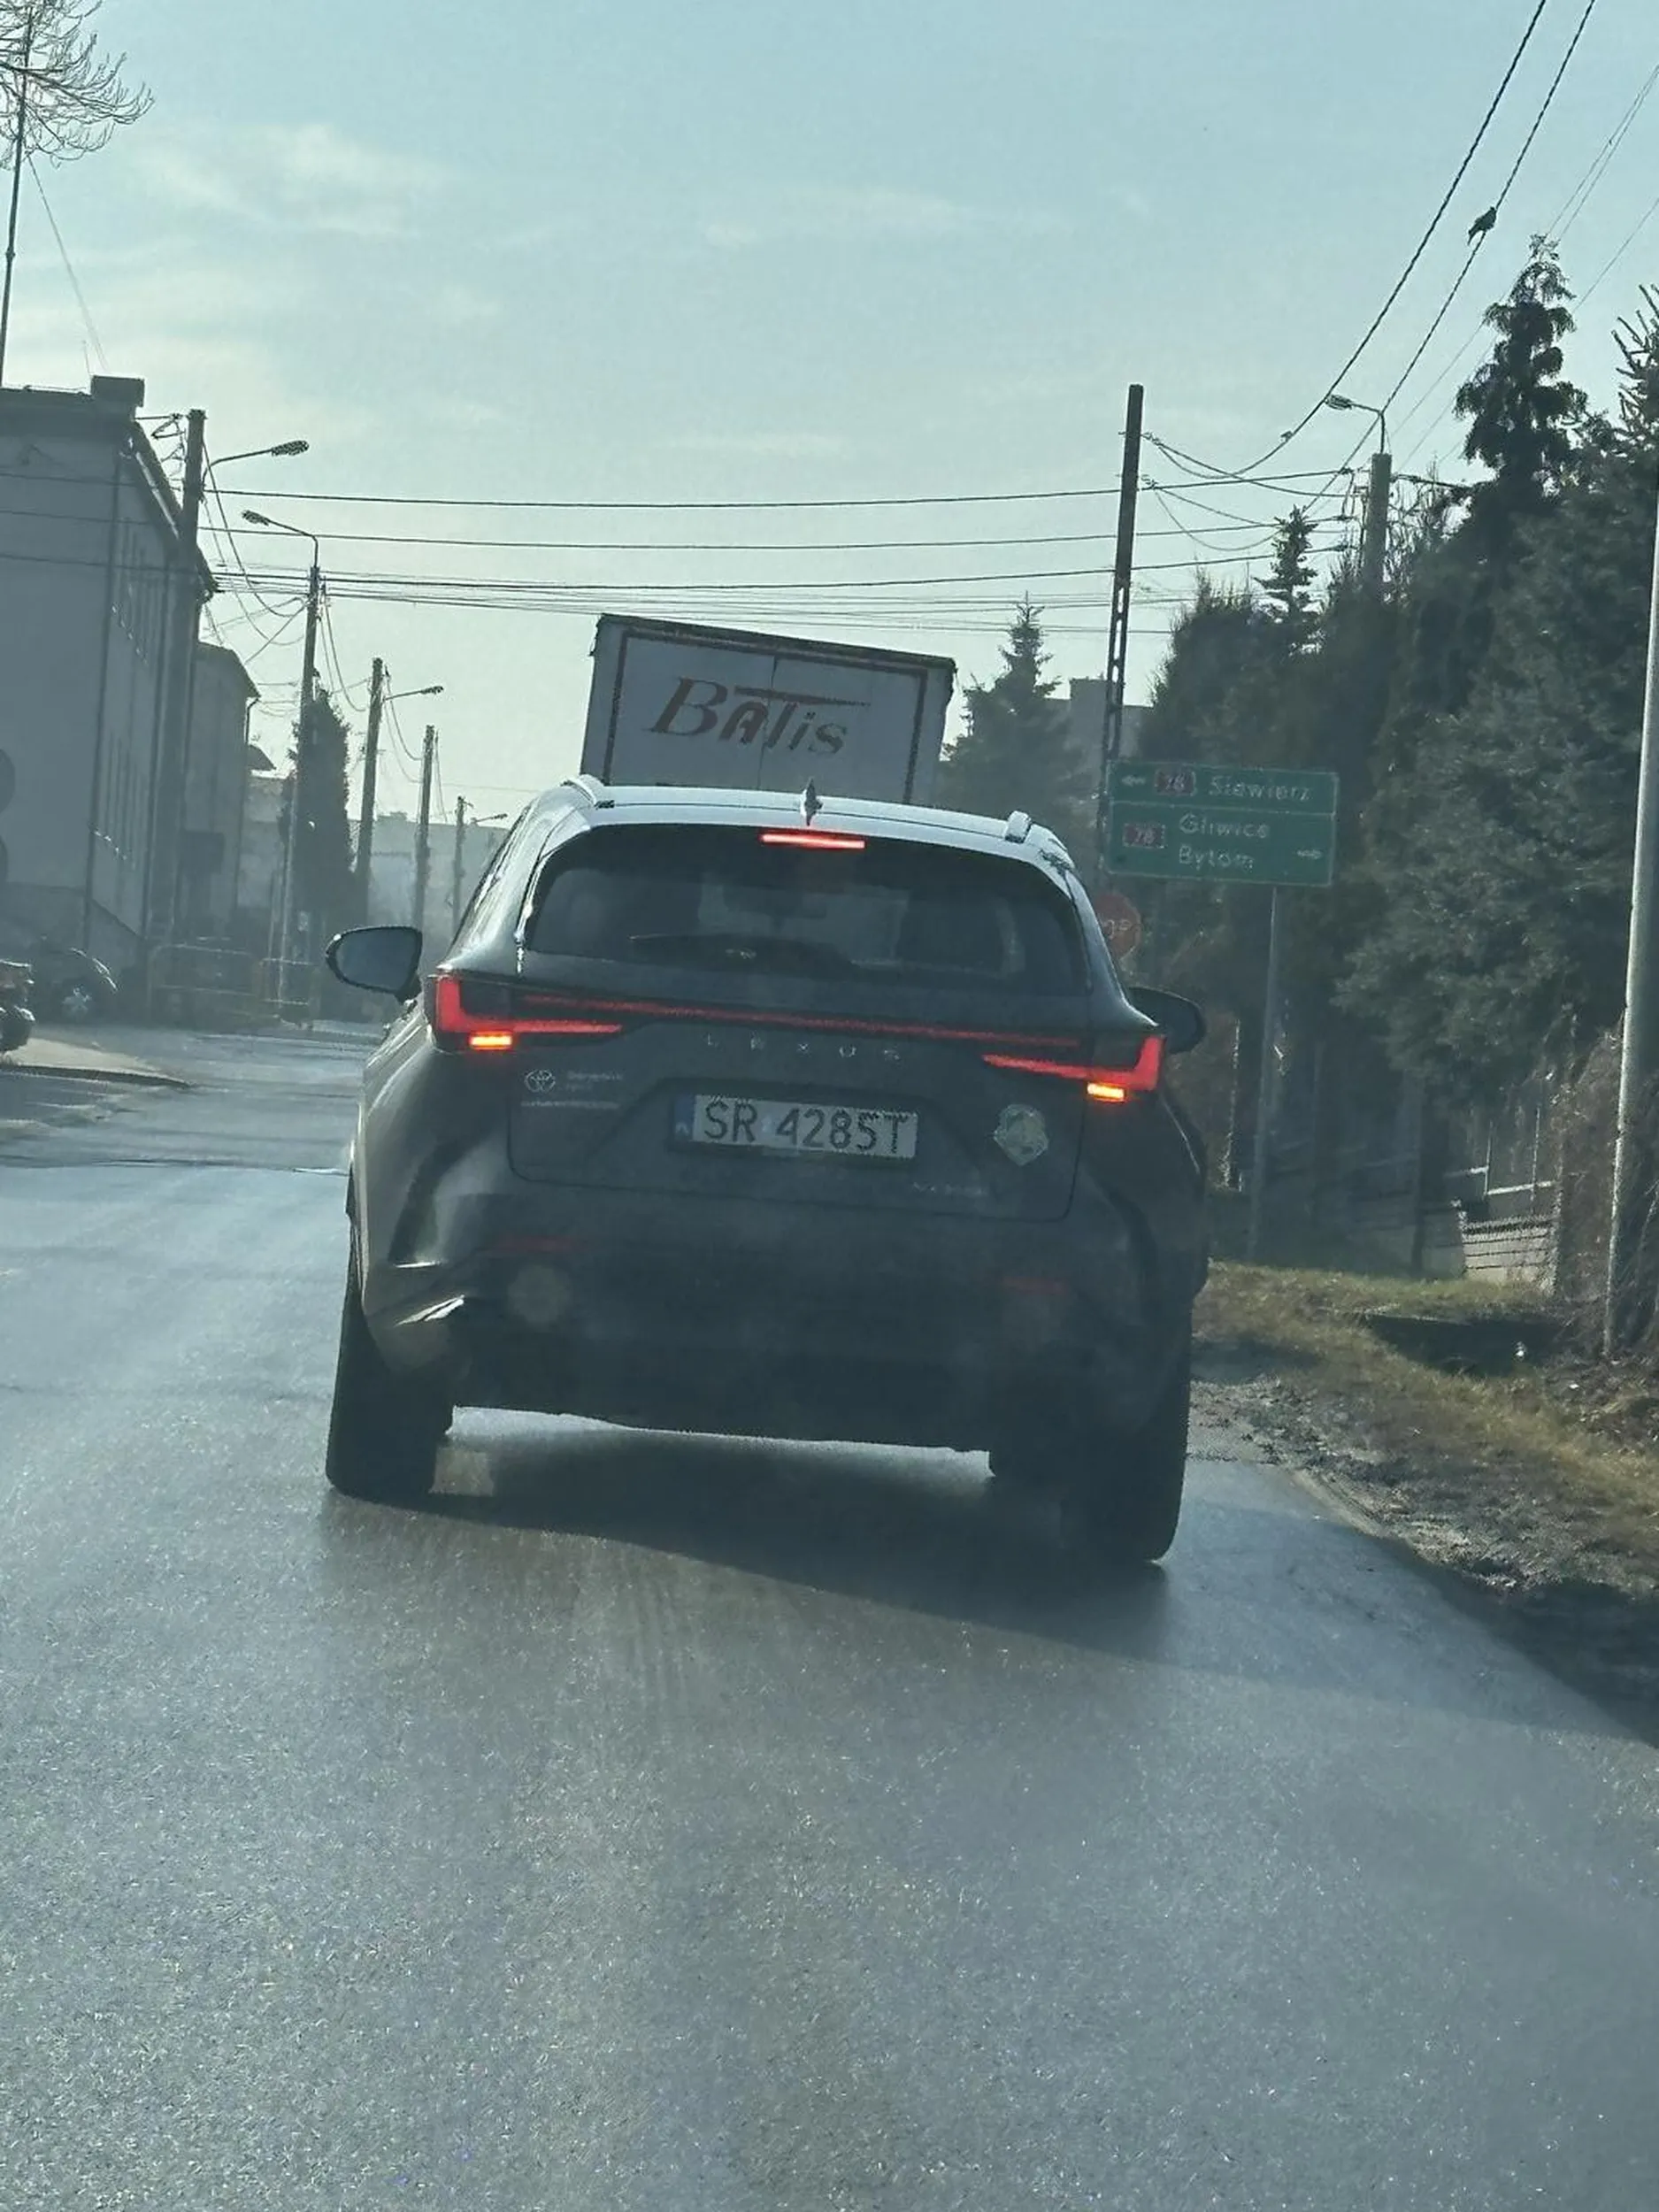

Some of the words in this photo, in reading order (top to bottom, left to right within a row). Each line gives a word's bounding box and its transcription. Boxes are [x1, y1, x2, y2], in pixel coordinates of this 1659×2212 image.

[1179, 812, 1271, 839] Gliwice
[1179, 844, 1256, 872] Bytom
[706, 1032, 901, 1060] LEXUS
[704, 1101, 758, 1142] SR
[775, 1109, 910, 1153] 4285T
